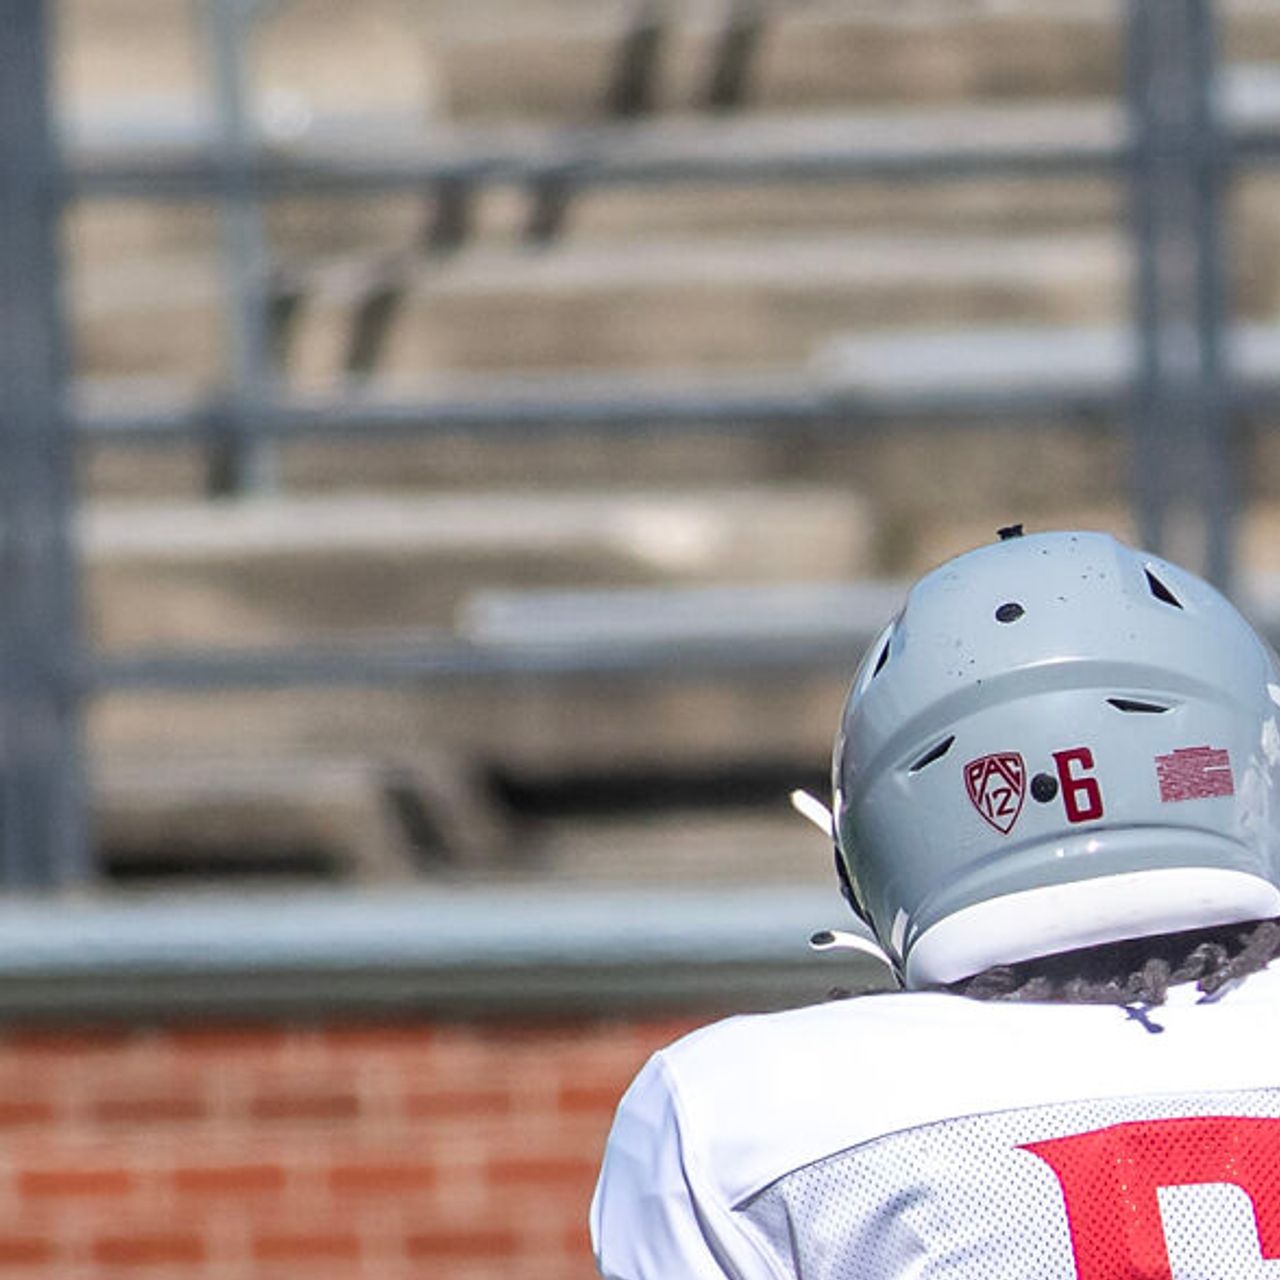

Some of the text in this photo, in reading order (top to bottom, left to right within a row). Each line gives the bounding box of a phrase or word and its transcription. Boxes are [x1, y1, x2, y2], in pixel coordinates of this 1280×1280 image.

[968, 756, 1021, 805] PAC
[985, 787, 1014, 818] 12
[1052, 747, 1104, 823] 6
